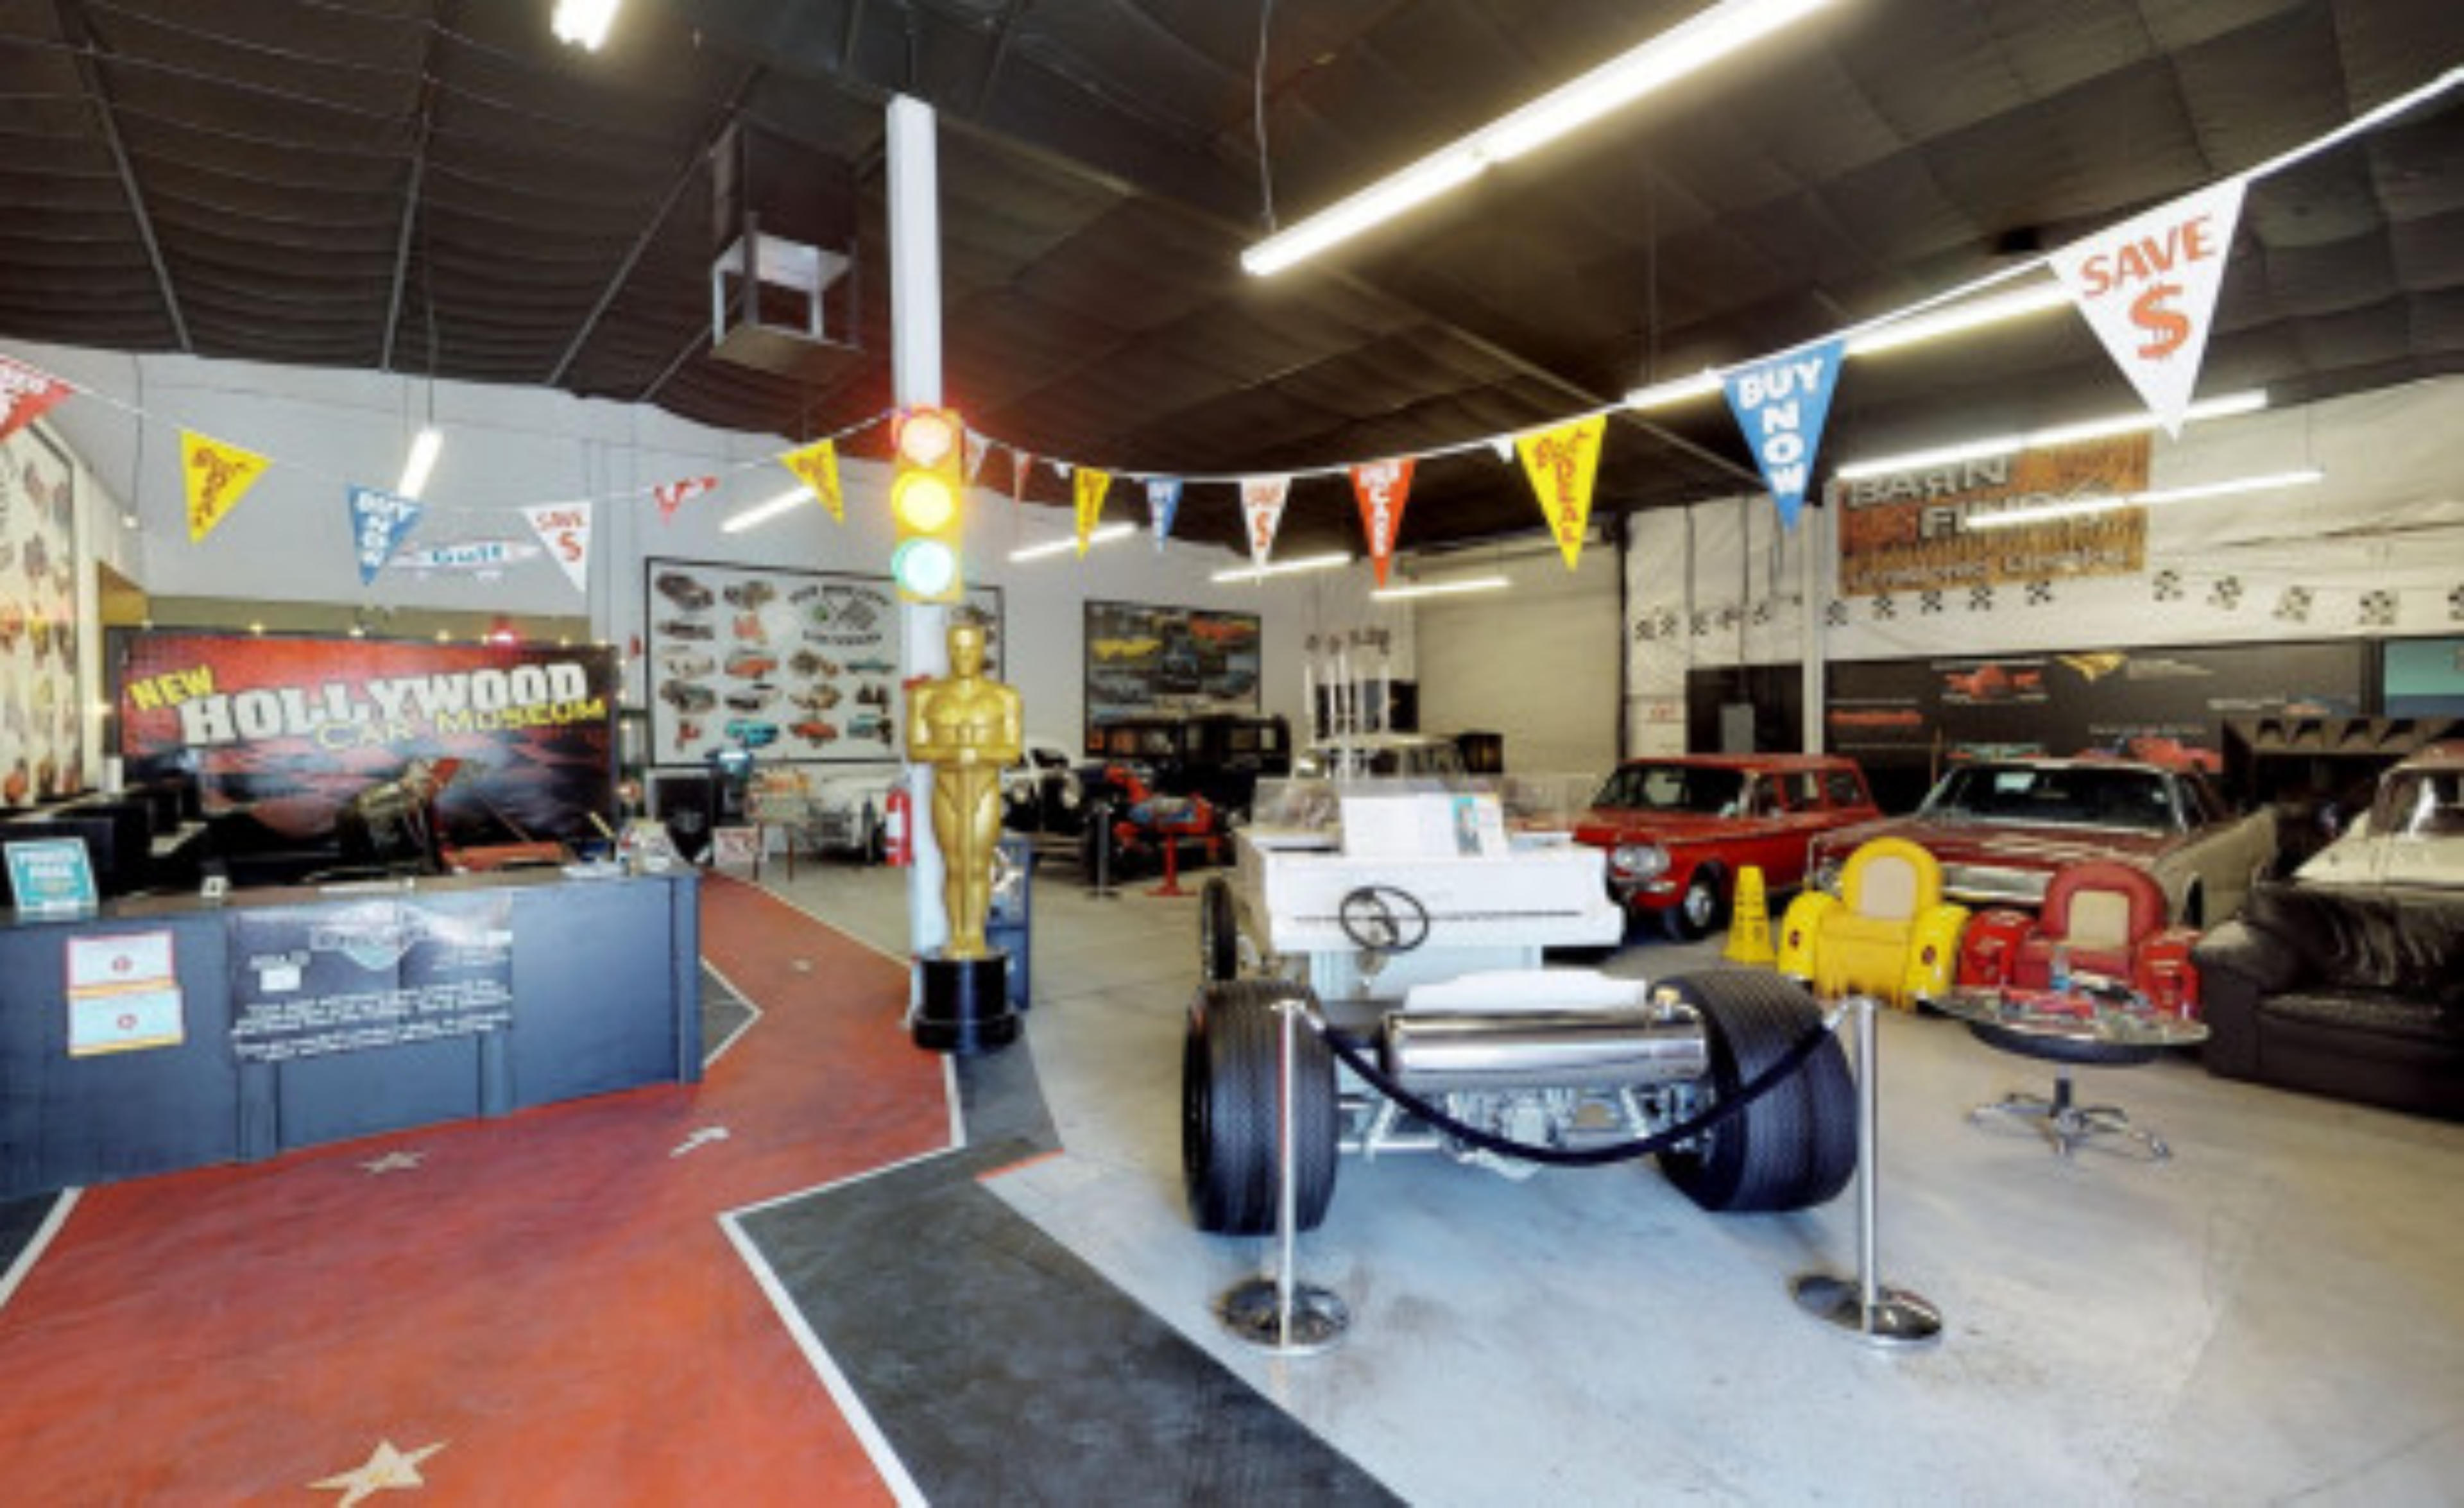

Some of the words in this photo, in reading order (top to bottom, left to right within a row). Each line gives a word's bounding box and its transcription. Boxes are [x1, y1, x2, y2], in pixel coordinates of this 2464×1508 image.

[2079, 213, 2217, 300] SAVE
[2128, 282, 2191, 361] $
[1738, 357, 1824, 410] BUY
[1762, 399, 1806, 495] NOW
[130, 664, 214, 711] NEW
[179, 662, 588, 746] HOLLYWOOD
[318, 718, 413, 751] CAR
[435, 697, 607, 735] MUSEUM
